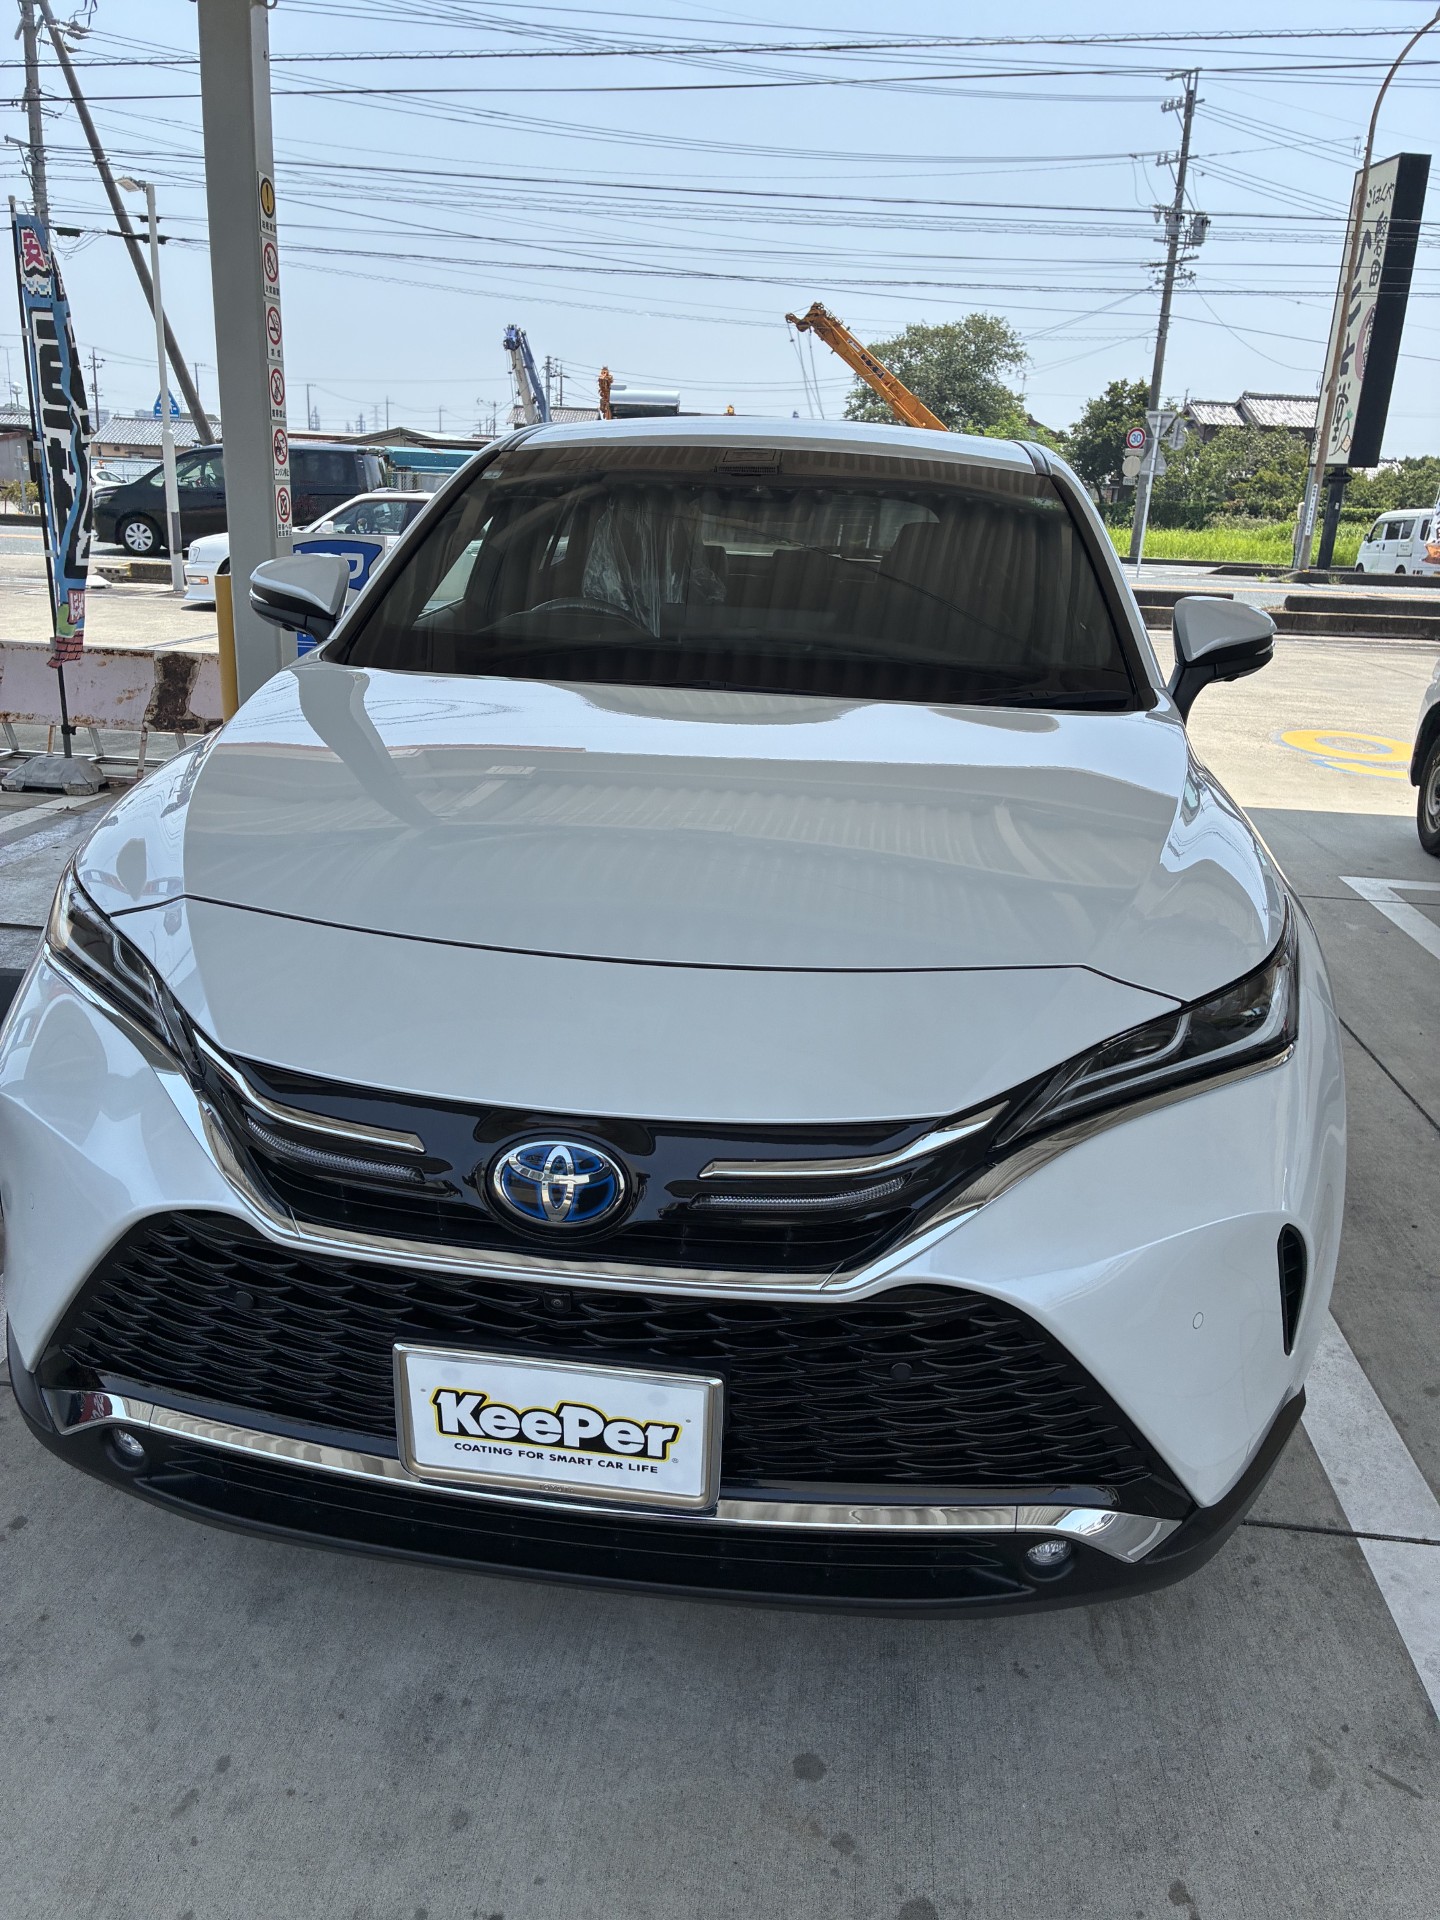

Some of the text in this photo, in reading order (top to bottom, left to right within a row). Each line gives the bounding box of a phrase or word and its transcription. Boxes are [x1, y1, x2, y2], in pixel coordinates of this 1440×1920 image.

[1131, 433, 1142, 443] 30
[434, 1389, 680, 1461] KeePer
[454, 1442, 658, 1474] COATING FOR SMART CAR LIFE
